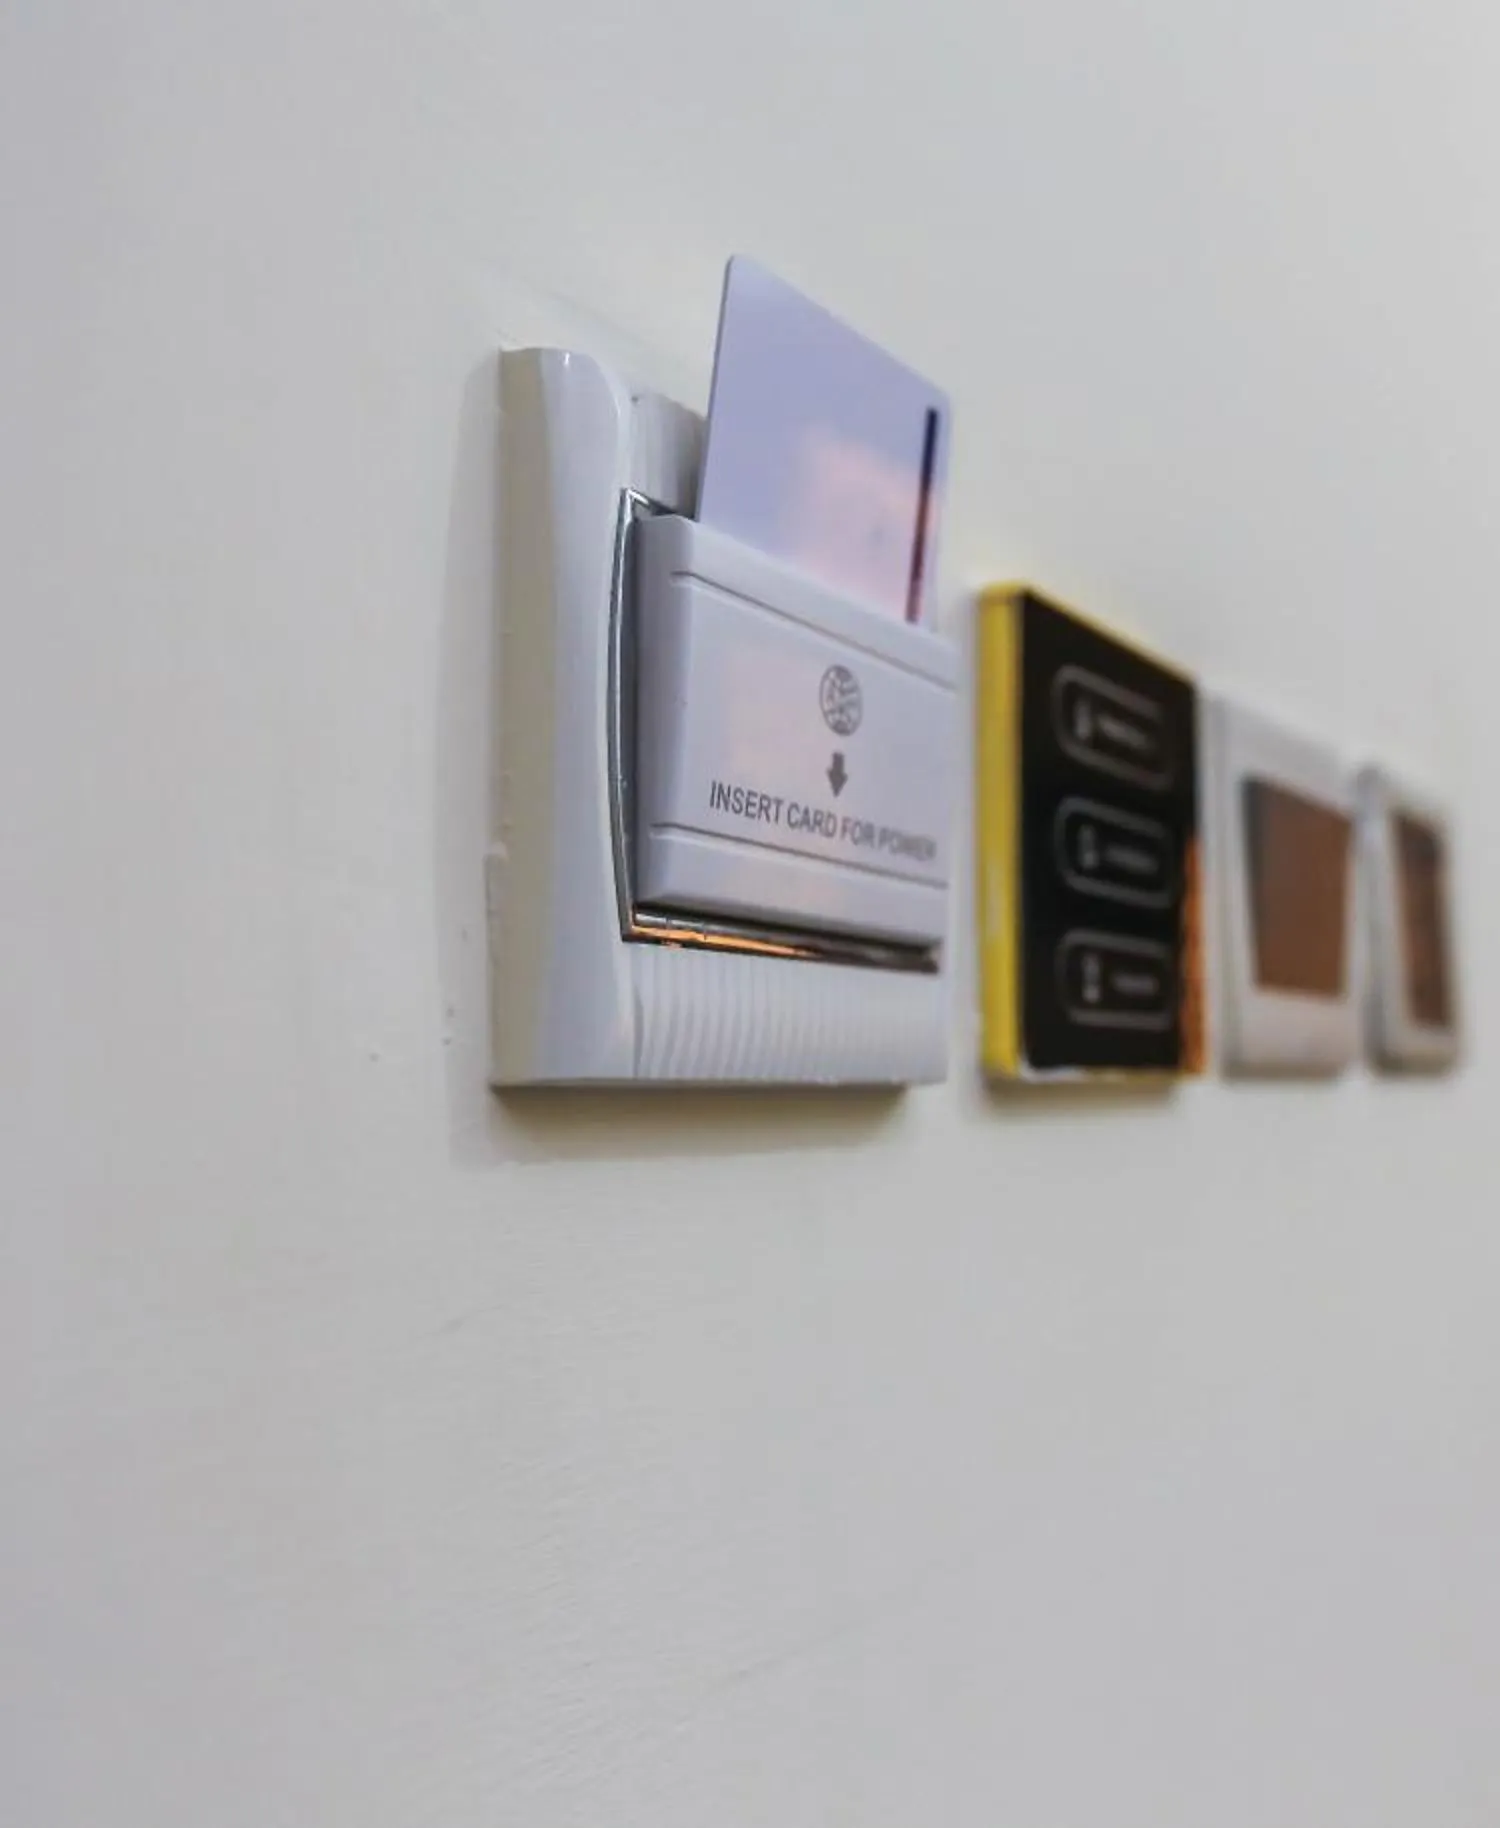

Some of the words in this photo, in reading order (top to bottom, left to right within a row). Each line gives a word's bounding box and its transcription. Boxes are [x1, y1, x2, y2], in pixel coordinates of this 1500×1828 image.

[709, 780, 784, 824] INSERT
[787, 802, 837, 838] CARD
[840, 816, 875, 850] FOR
